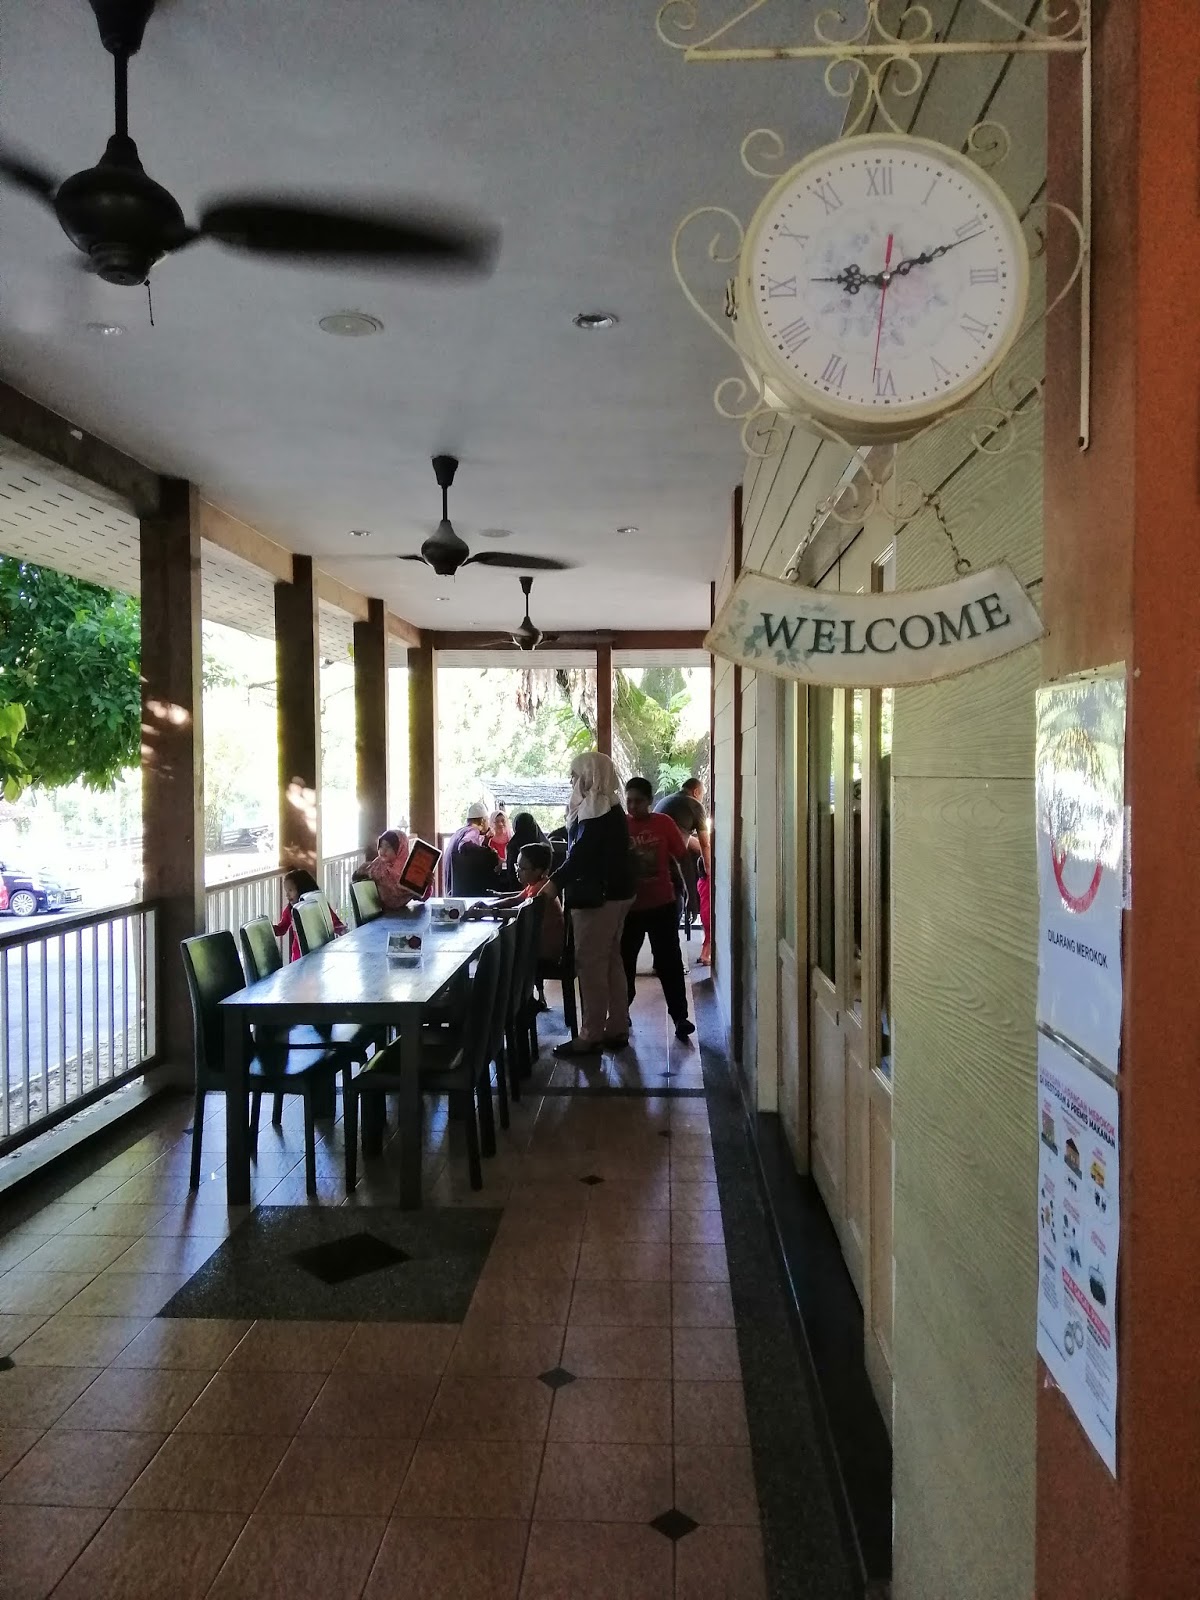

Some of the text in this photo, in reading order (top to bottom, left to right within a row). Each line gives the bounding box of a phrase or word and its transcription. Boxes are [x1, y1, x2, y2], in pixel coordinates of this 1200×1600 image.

[867, 167, 893, 196] XII
[921, 179, 938, 206] I
[812, 181, 844, 215] XI
[779, 224, 809, 248] X
[954, 215, 982, 238] II
[768, 276, 797, 298] IX
[970, 268, 998, 285] III
[779, 317, 811, 353] VIII
[960, 313, 989, 343] IV
[820, 354, 848, 389] VII
[875, 367, 897, 396] VI
[930, 356, 950, 382] V
[760, 592, 1011, 655] WELCOME
[1048, 929, 1108, 969] DILARANG MEROKOK
[1071, 1102, 1088, 1125] PREMIS
[1089, 1118, 1115, 1149] MAKANAN
